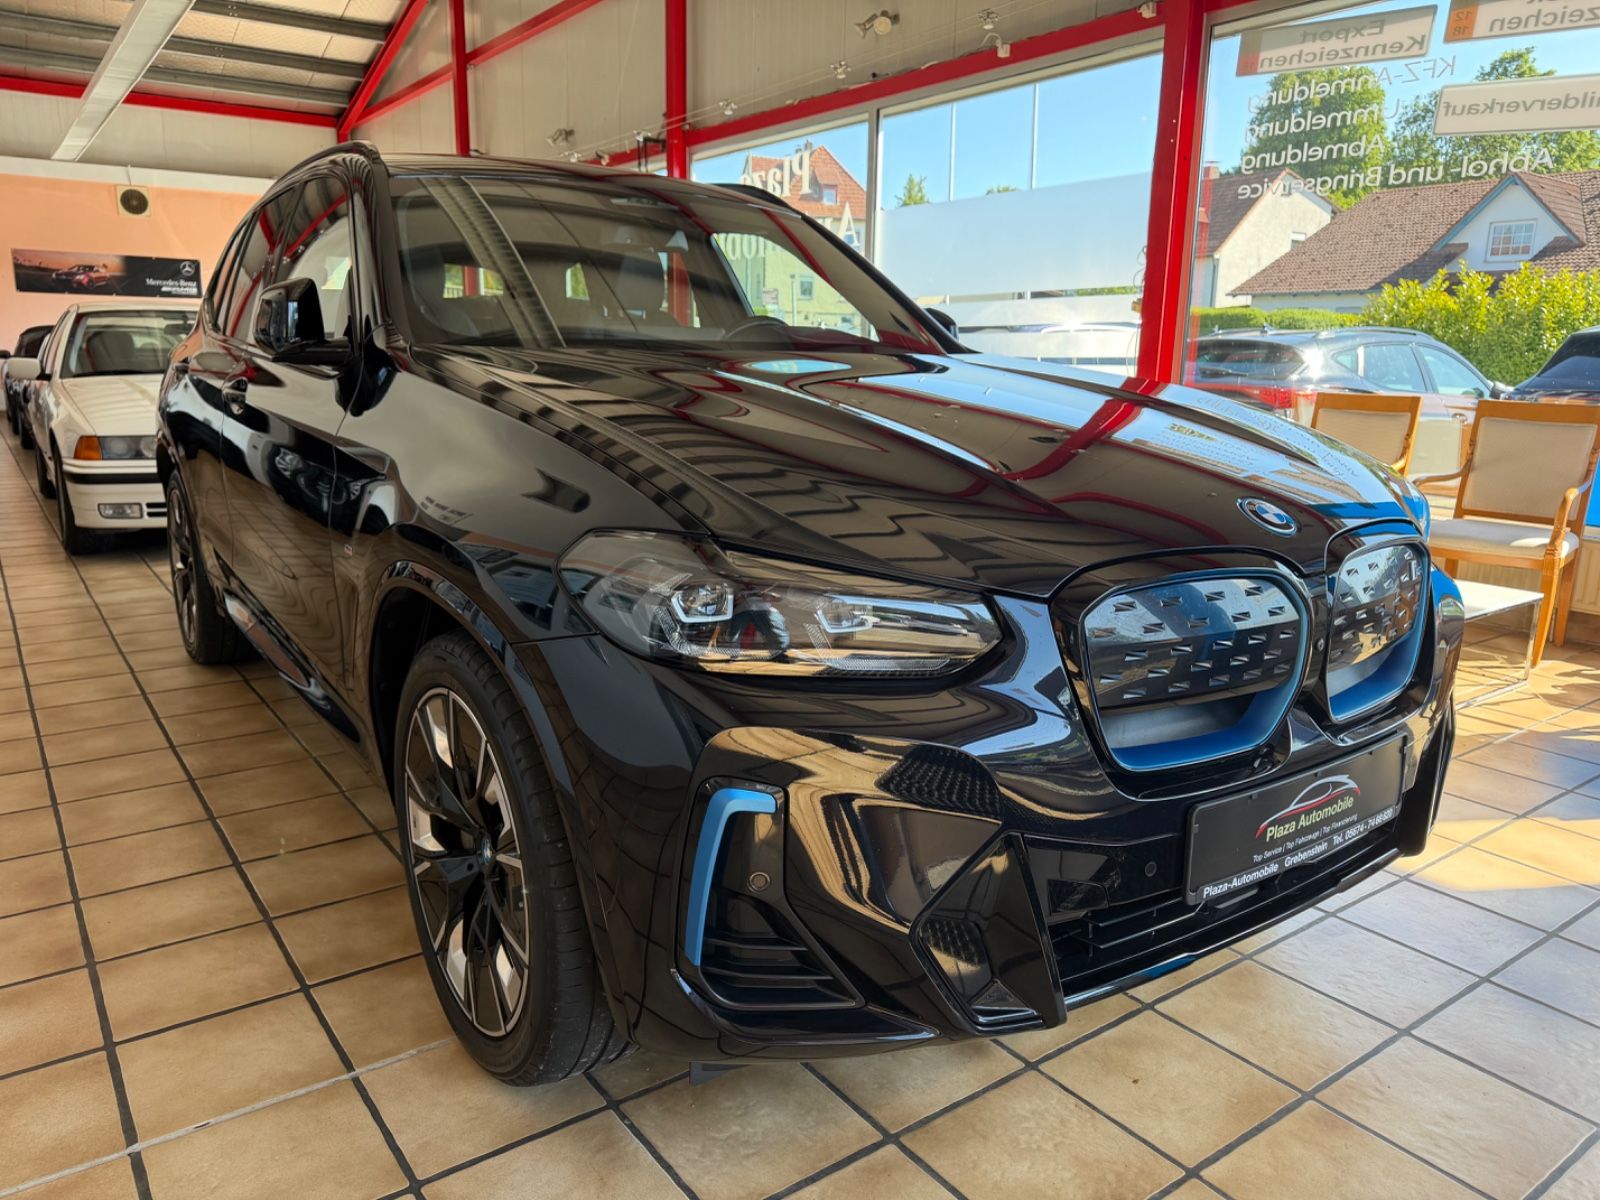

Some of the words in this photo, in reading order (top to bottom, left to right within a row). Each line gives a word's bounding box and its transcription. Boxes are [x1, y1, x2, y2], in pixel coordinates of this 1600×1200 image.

[1266, 821, 1296, 842] Plaza
[1297, 796, 1354, 829] Automobile
[1203, 863, 1279, 899] Plaza-Automobile
[1284, 841, 1329, 867] Grebenstein
